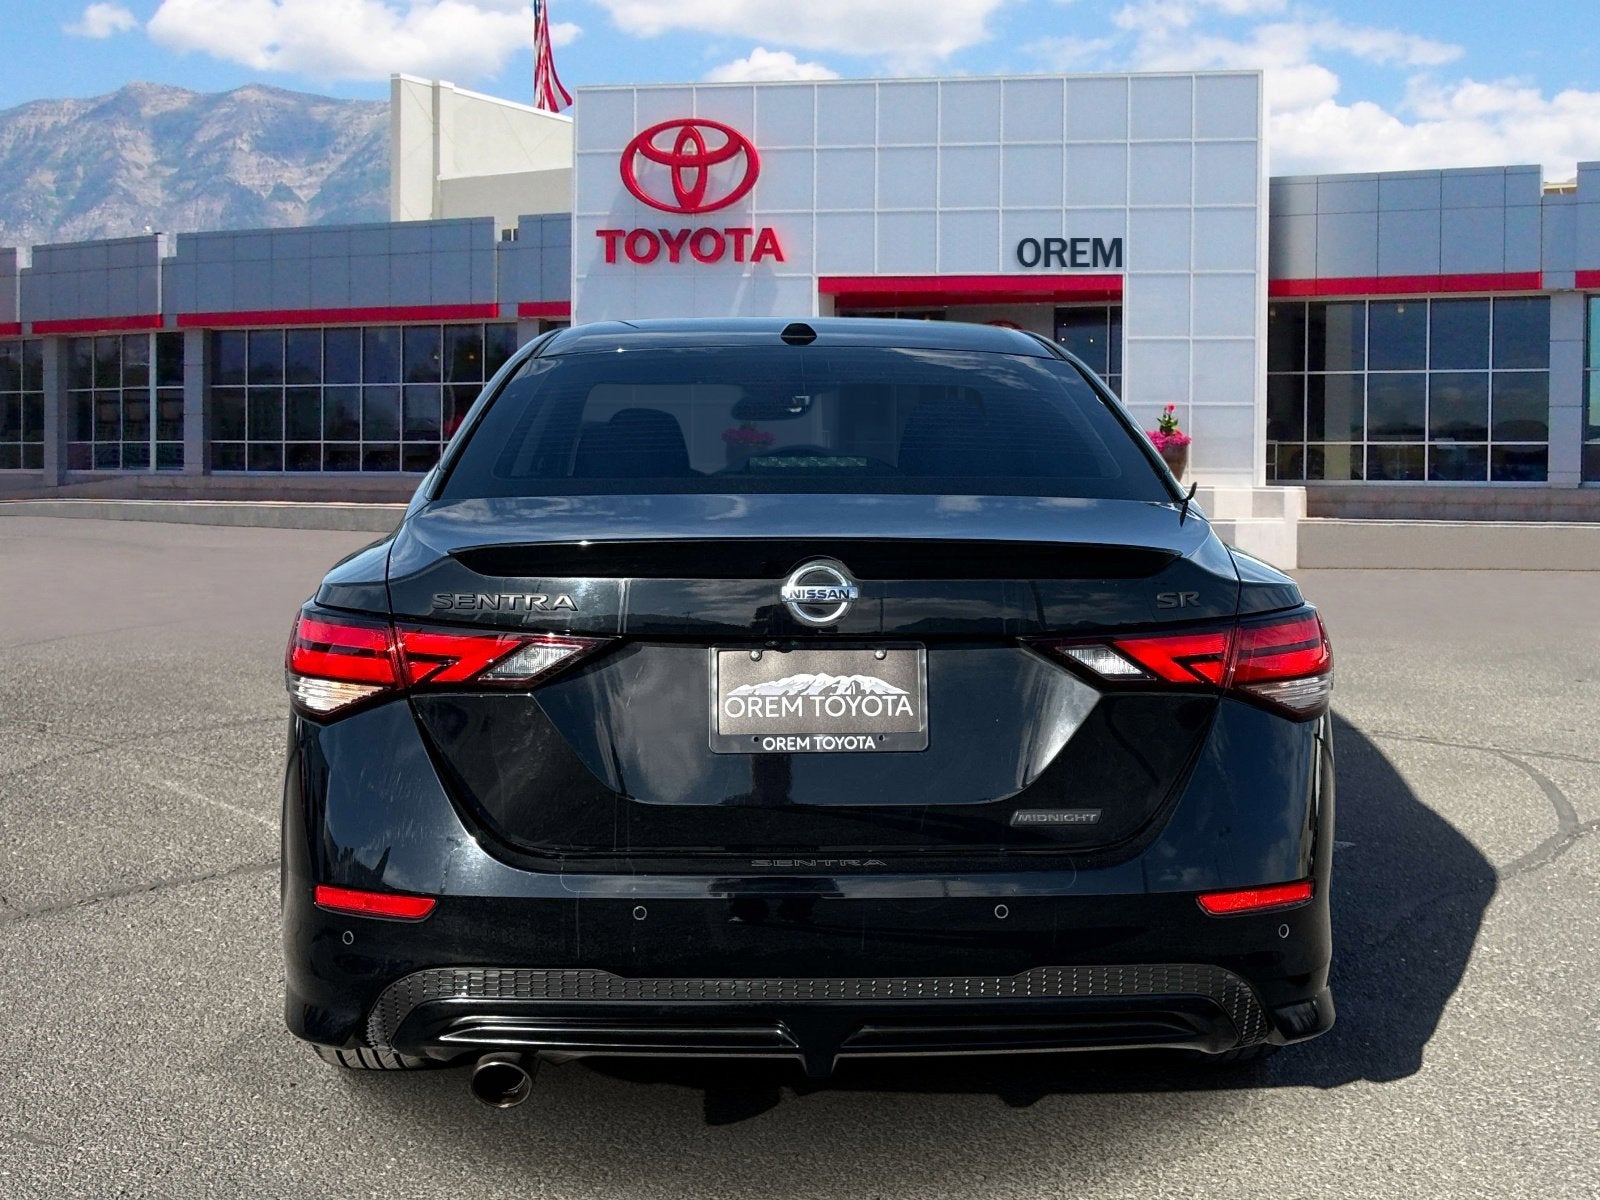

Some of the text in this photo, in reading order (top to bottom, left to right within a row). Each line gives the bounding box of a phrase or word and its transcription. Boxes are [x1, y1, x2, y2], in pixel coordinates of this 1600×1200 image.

[595, 227, 785, 264] TOYOTA
[1016, 237, 1123, 269] OREM
[432, 592, 578, 611] SENTRA
[789, 588, 851, 600] NISSAN
[1156, 591, 1200, 609] SR
[724, 695, 914, 718] OREM TOYOTA
[762, 735, 876, 751] OREM TOYOTA
[1017, 812, 1097, 823] MIDNIGHT
[751, 858, 887, 867] SENTRA
